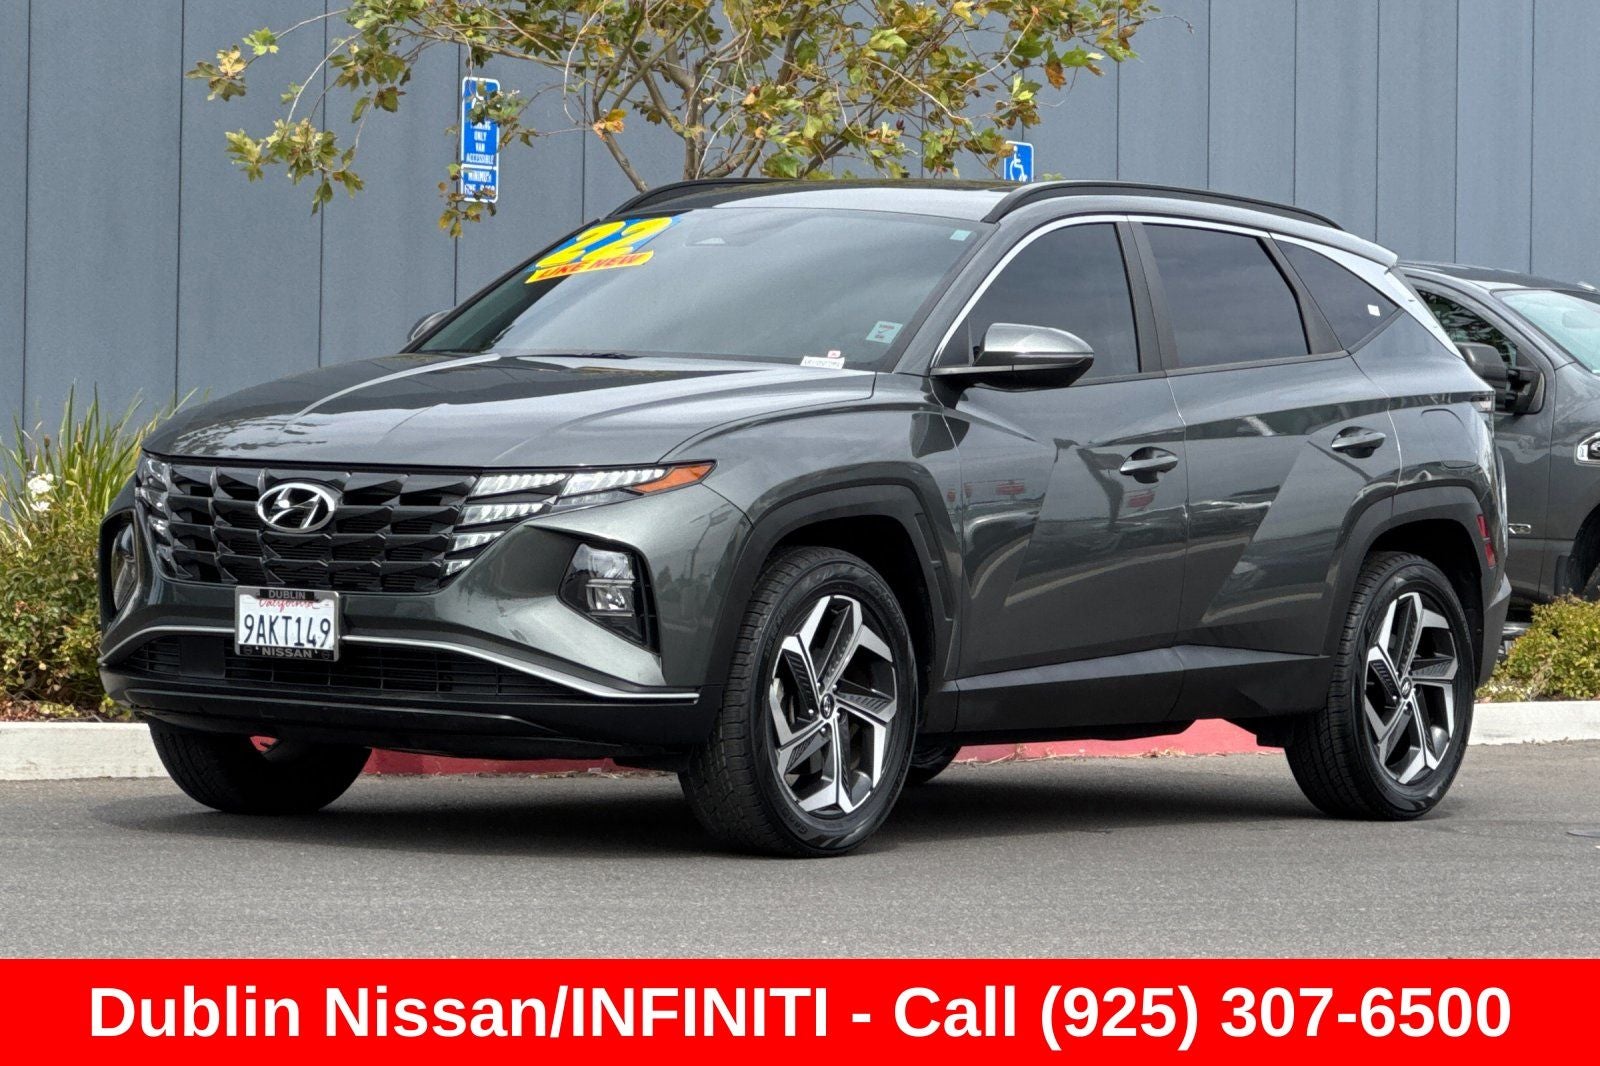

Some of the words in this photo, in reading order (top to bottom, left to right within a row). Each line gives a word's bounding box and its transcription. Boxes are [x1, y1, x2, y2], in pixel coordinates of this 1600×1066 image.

[474, 131, 487, 141] ONLY
[475, 142, 485, 152] VAN
[466, 153, 494, 164] ACCESSIBLE
[536, 217, 672, 266] 22
[588, 253, 644, 268] NEW
[268, 590, 306, 599] DUBLIN
[244, 614, 331, 648] 9AKT149
[261, 646, 312, 658] NISSAN
